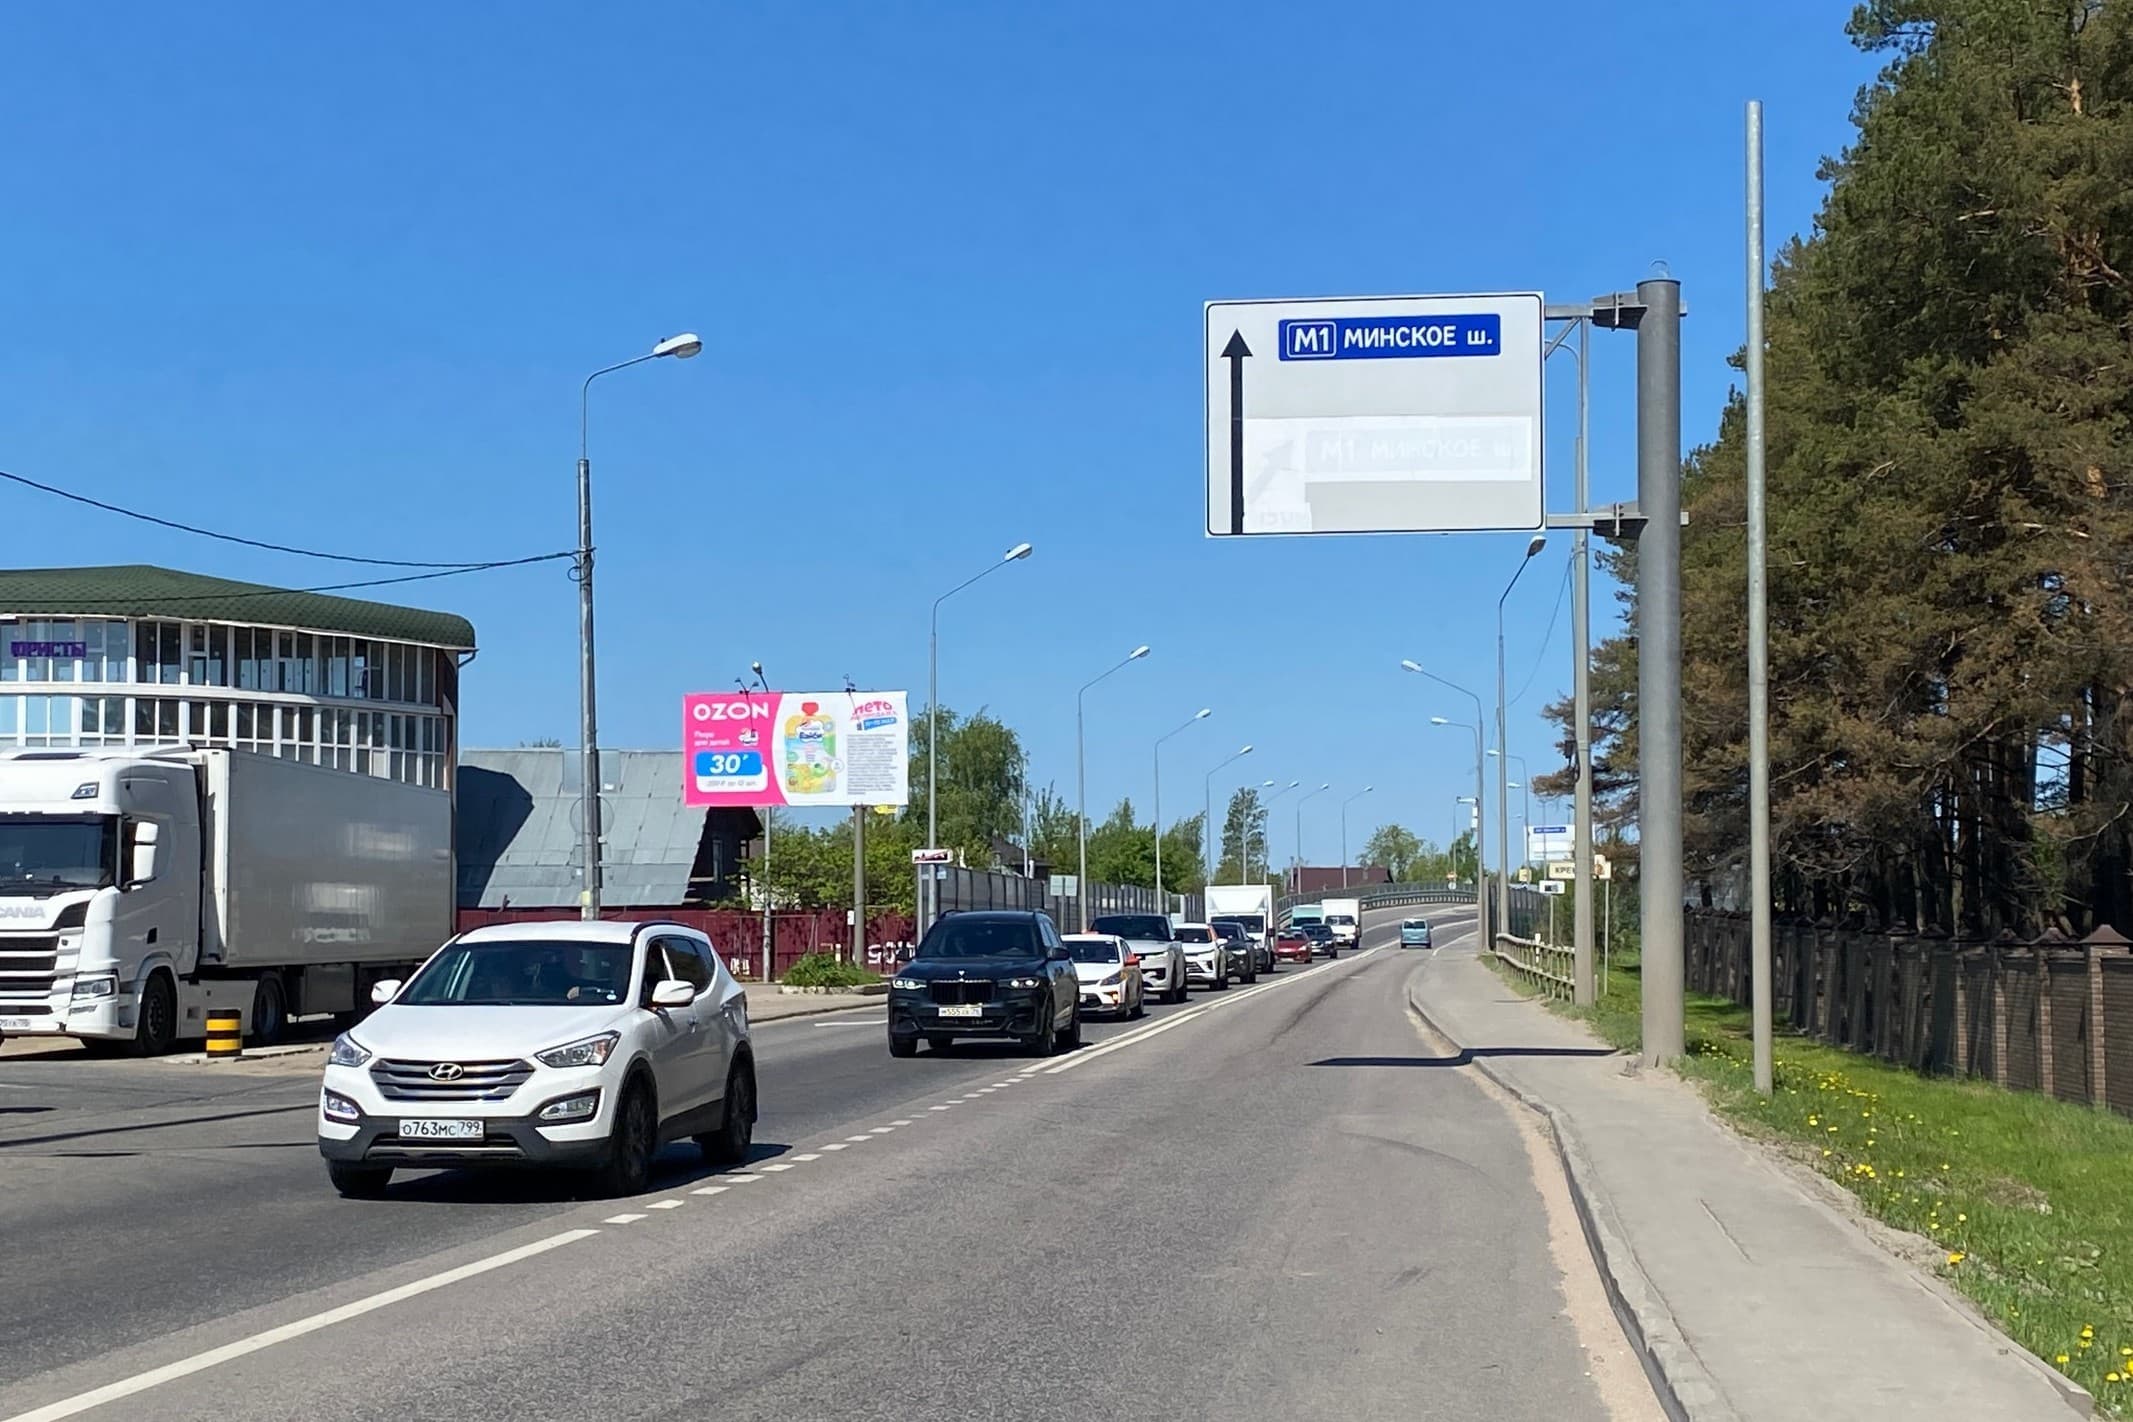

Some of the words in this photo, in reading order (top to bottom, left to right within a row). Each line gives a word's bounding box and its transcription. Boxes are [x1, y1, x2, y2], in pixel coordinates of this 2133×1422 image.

[1294, 328, 1330, 352] М1
[1344, 325, 1457, 349] МИНСКОЕ
[1467, 330, 1494, 345] ш.
[693, 702, 769, 721] OZON
